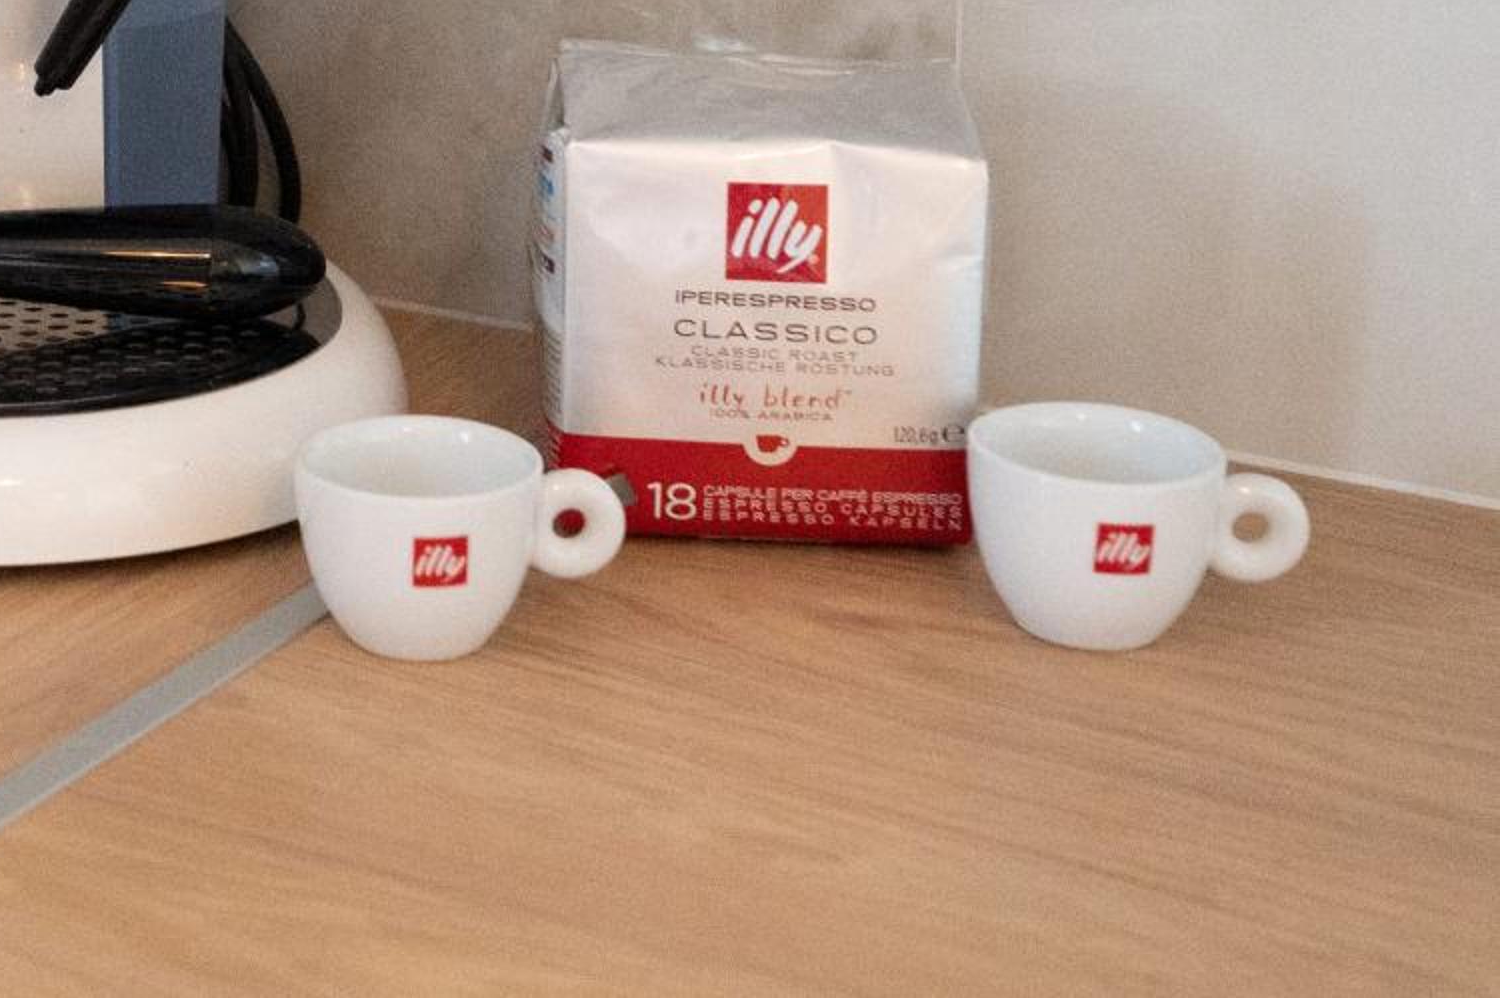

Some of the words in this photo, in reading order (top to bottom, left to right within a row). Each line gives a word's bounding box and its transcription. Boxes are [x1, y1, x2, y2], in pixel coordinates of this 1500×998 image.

[730, 197, 823, 274] illy
[675, 289, 876, 312] IPERESPRESSO
[673, 319, 878, 345] CLASSICO
[655, 357, 785, 373] KLASSISCHE
[691, 345, 780, 360] CLASSIC
[789, 348, 859, 363] ROAST
[700, 383, 743, 411] illy
[647, 481, 697, 520] 18
[703, 484, 778, 500] CAPSULE
[781, 487, 814, 501] PER
[871, 490, 963, 505] ESPRESSO
[703, 497, 828, 514] ESPRESSO
[840, 503, 963, 519] CAPSULES
[703, 509, 835, 526] ESPRESSO
[850, 515, 963, 531] KAPSELN
[415, 545, 466, 583] illy
